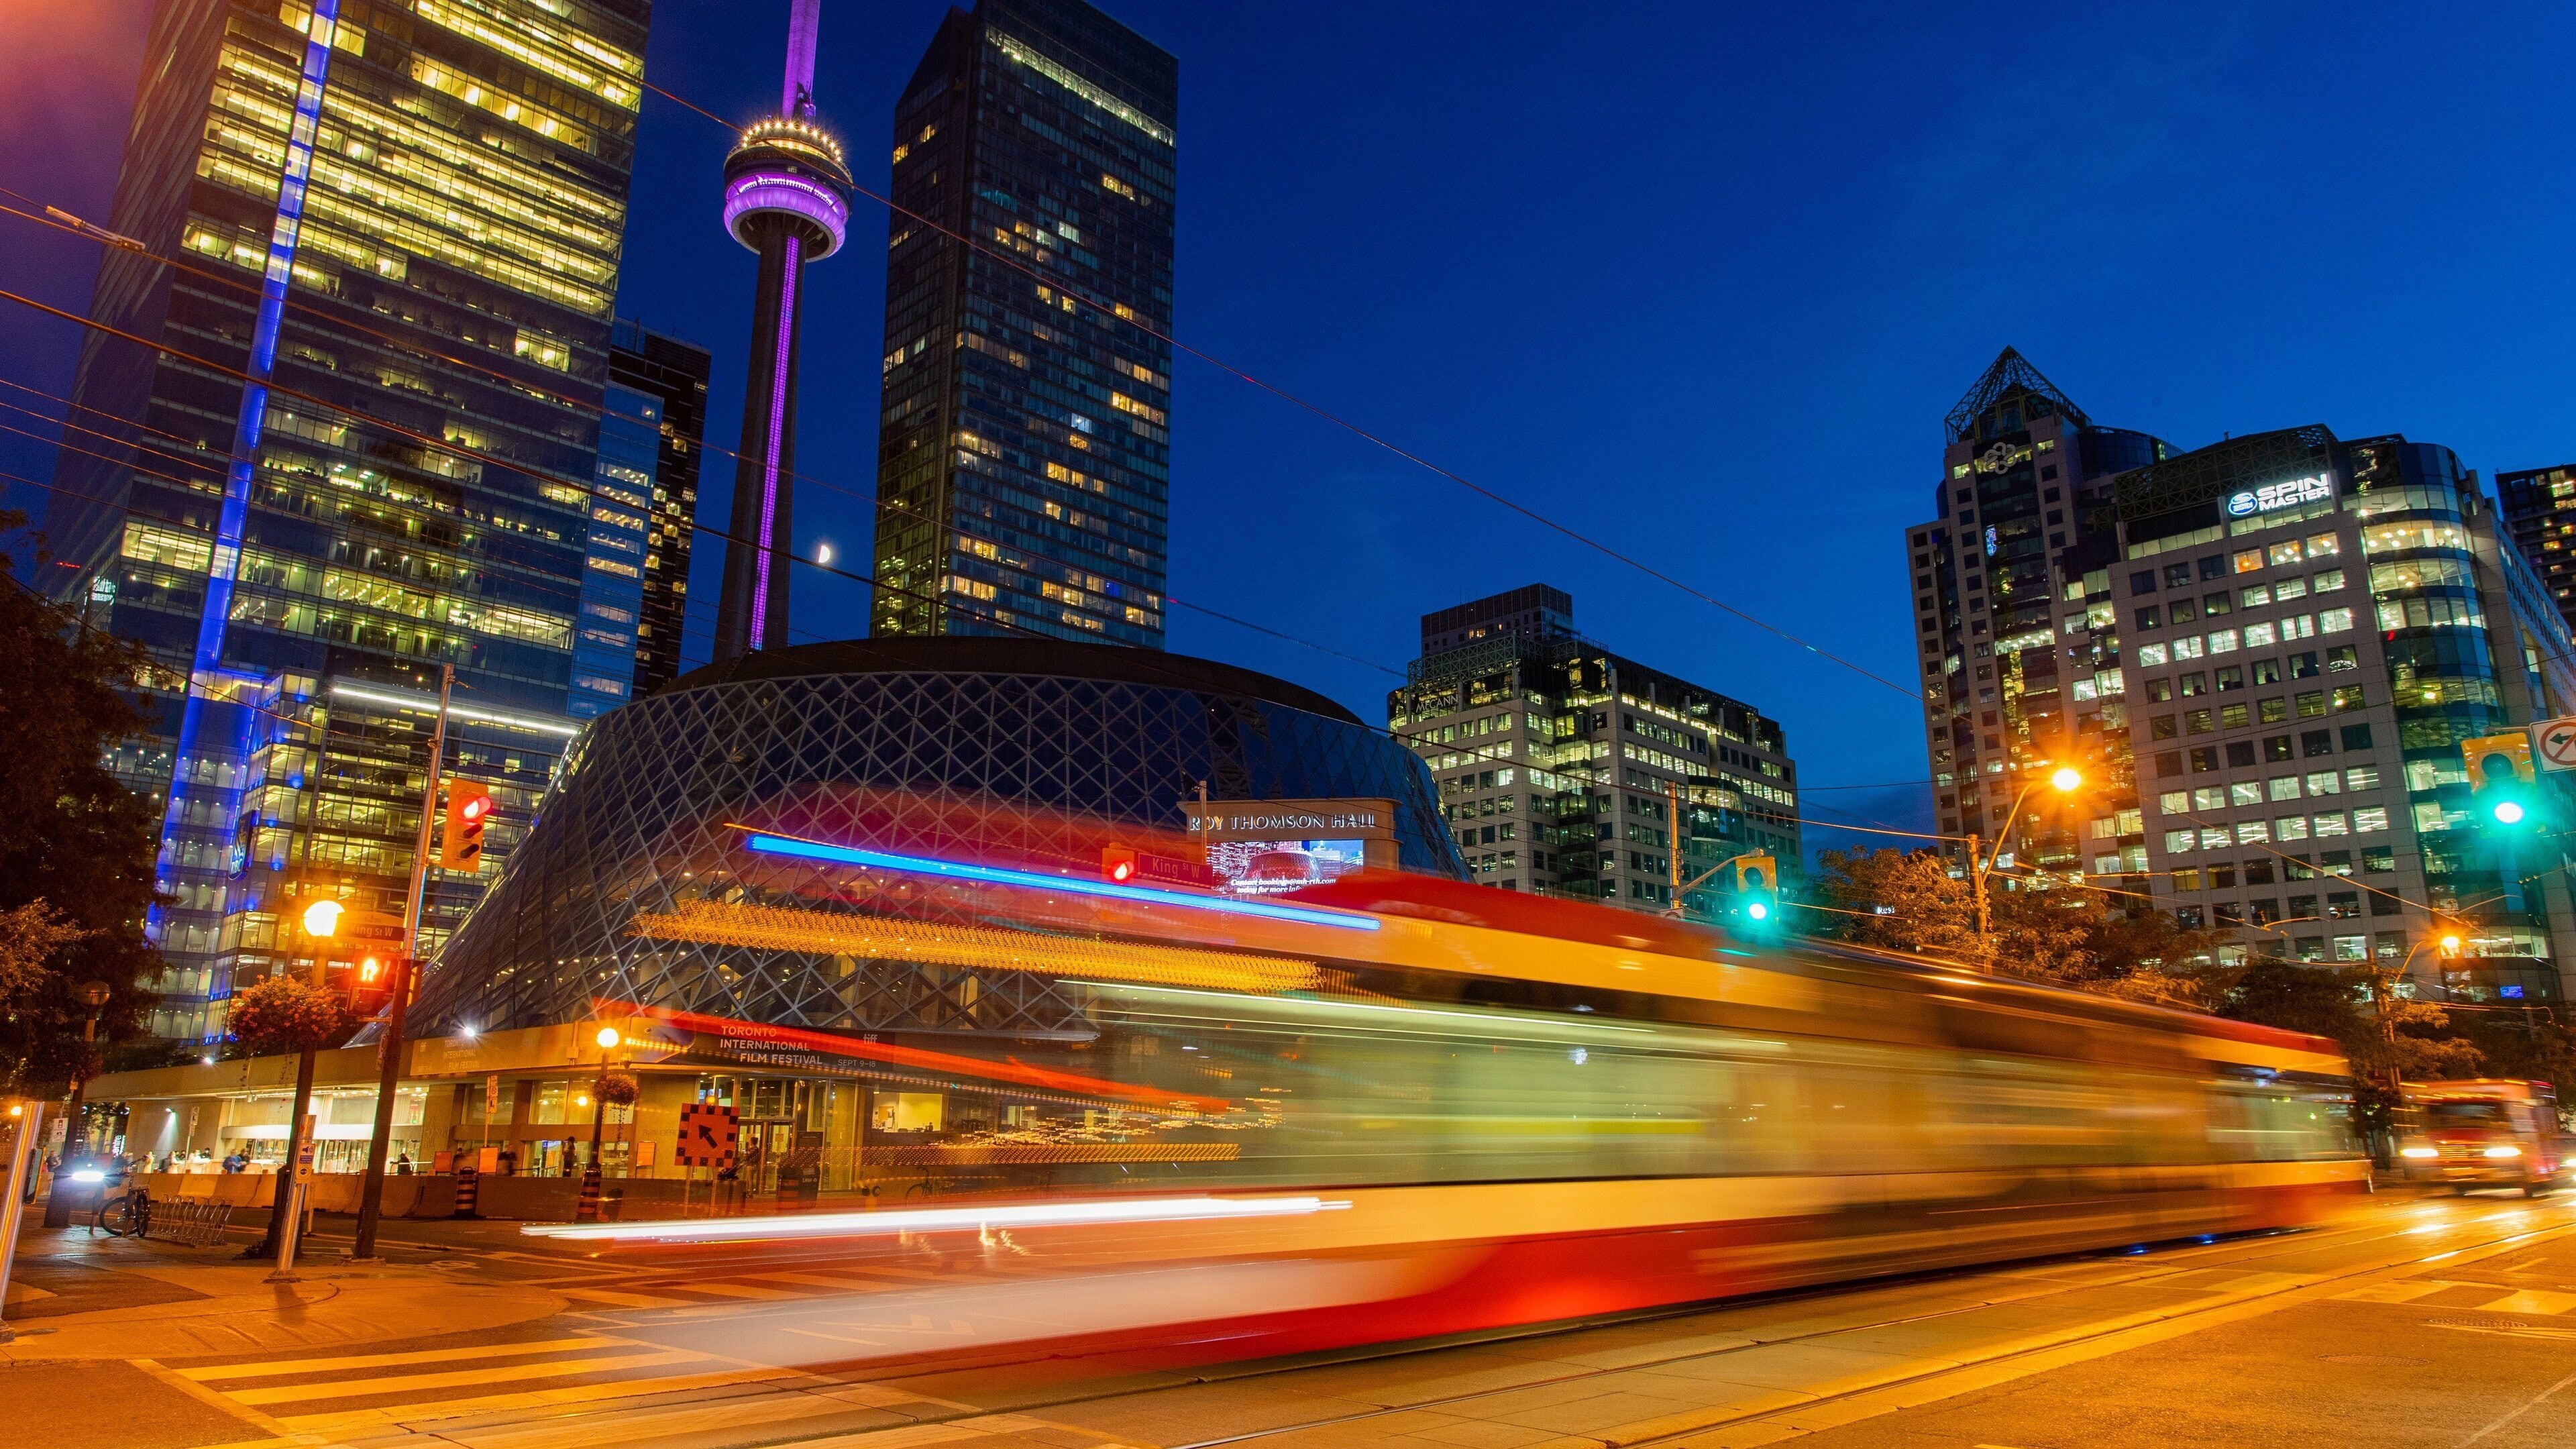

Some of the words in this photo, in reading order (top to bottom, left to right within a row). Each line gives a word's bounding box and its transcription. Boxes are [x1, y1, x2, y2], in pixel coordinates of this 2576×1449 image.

[2257, 474, 2328, 501] SPIN
[2258, 486, 2330, 511] MASTER
[1415, 694, 1458, 713] McCANN
[1230, 814, 1325, 830] THOMSON
[1331, 813, 1375, 829] HALL
[230, 858, 242, 875] RBC
[1152, 858, 1178, 879] King
[1182, 863, 1189, 871] St
[1191, 864, 1200, 879] W
[1236, 886, 1258, 894] today
[1257, 886, 1269, 894] for
[350, 924, 372, 937] King
[375, 928, 382, 936] St
[385, 927, 393, 936] W
[721, 1025, 777, 1036] TORONTO
[720, 1039, 810, 1051] INTERNATIONAL
[863, 1033, 878, 1045] tiff
[740, 1053, 767, 1063] FILM
[771, 1054, 822, 1065] FESTIVAL
[838, 1059, 858, 1067] SEPT
